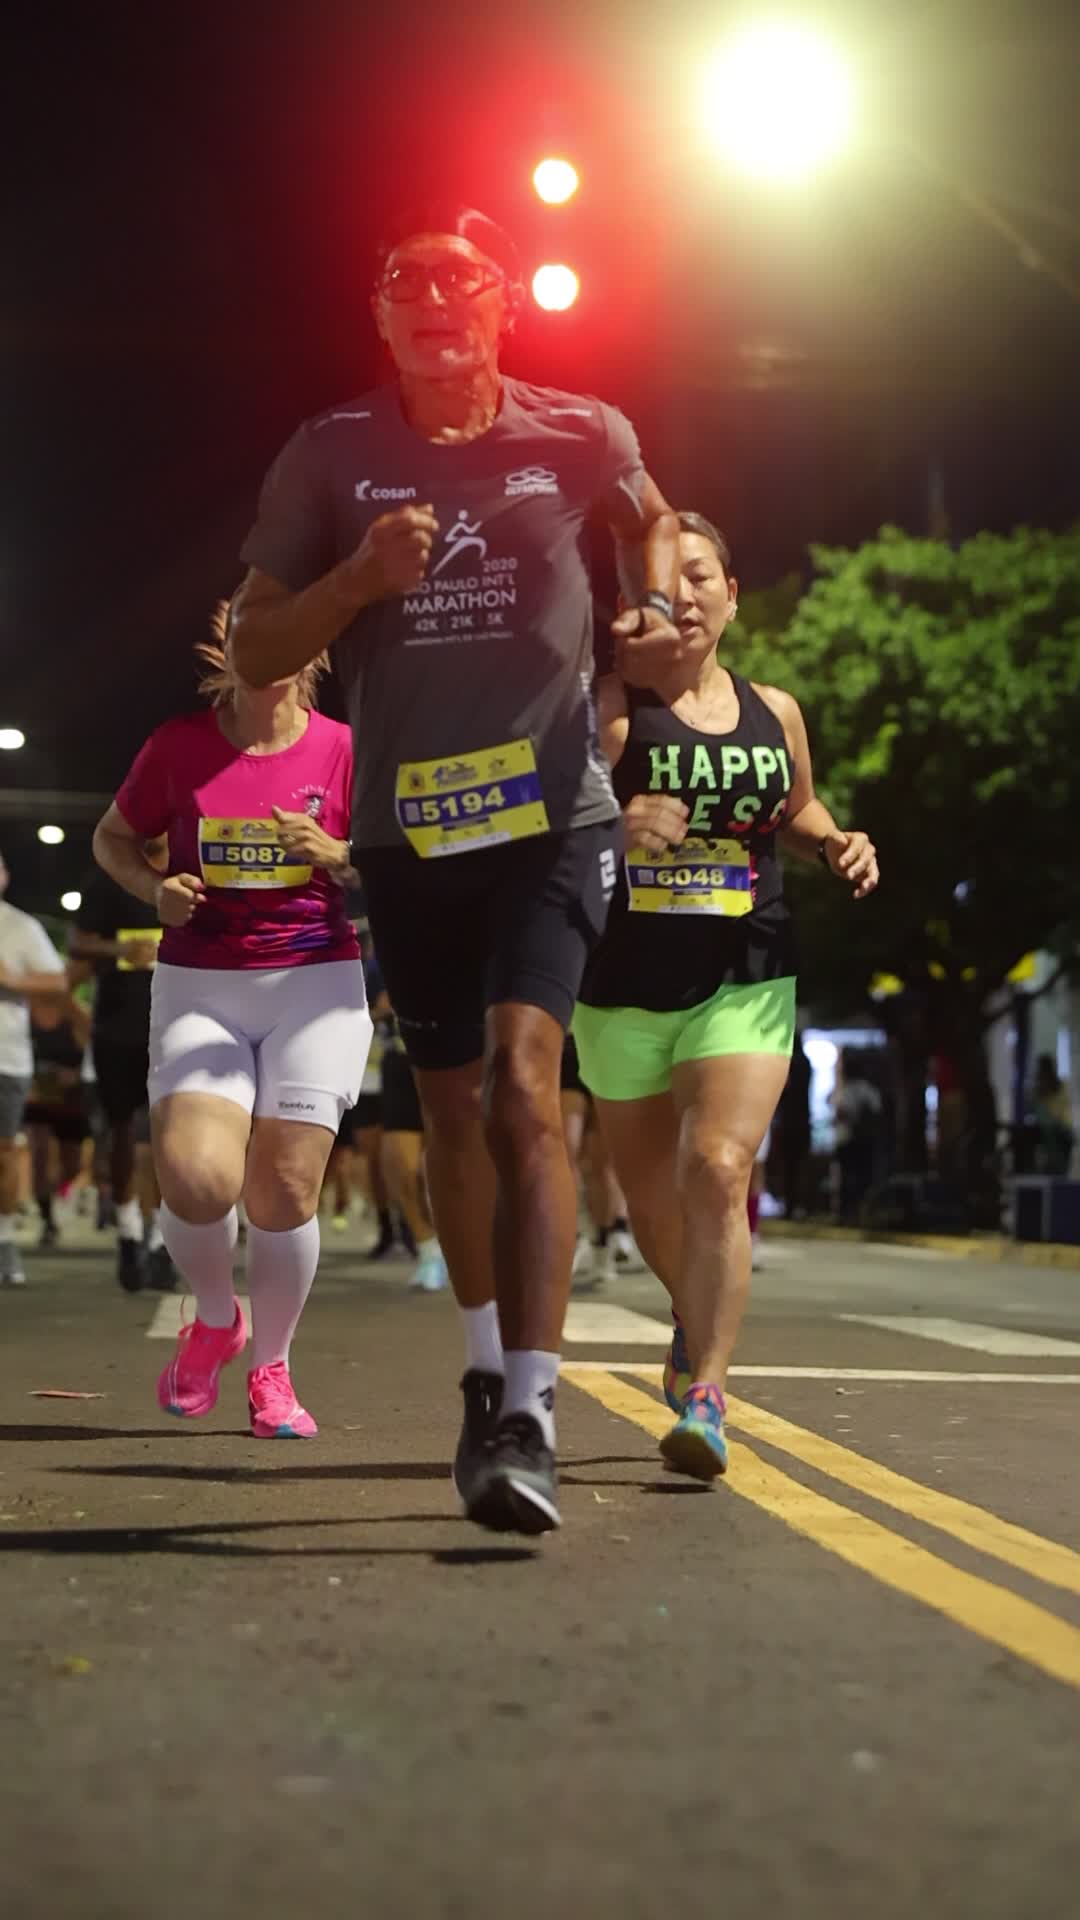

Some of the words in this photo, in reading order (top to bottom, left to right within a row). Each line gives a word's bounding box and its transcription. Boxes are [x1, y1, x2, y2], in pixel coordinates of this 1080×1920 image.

[371, 487, 417, 500] cosan
[482, 557, 519, 573] 2020
[433, 576, 480, 593] PAULO
[402, 588, 517, 615] MARATHON
[415, 618, 439, 632] 42K
[451, 615, 474, 629] 21K
[487, 612, 504, 625] 5K
[420, 785, 506, 822] 5194
[675, 795, 789, 833] ESS
[225, 846, 288, 864] 5087
[656, 868, 726, 887] 6048
